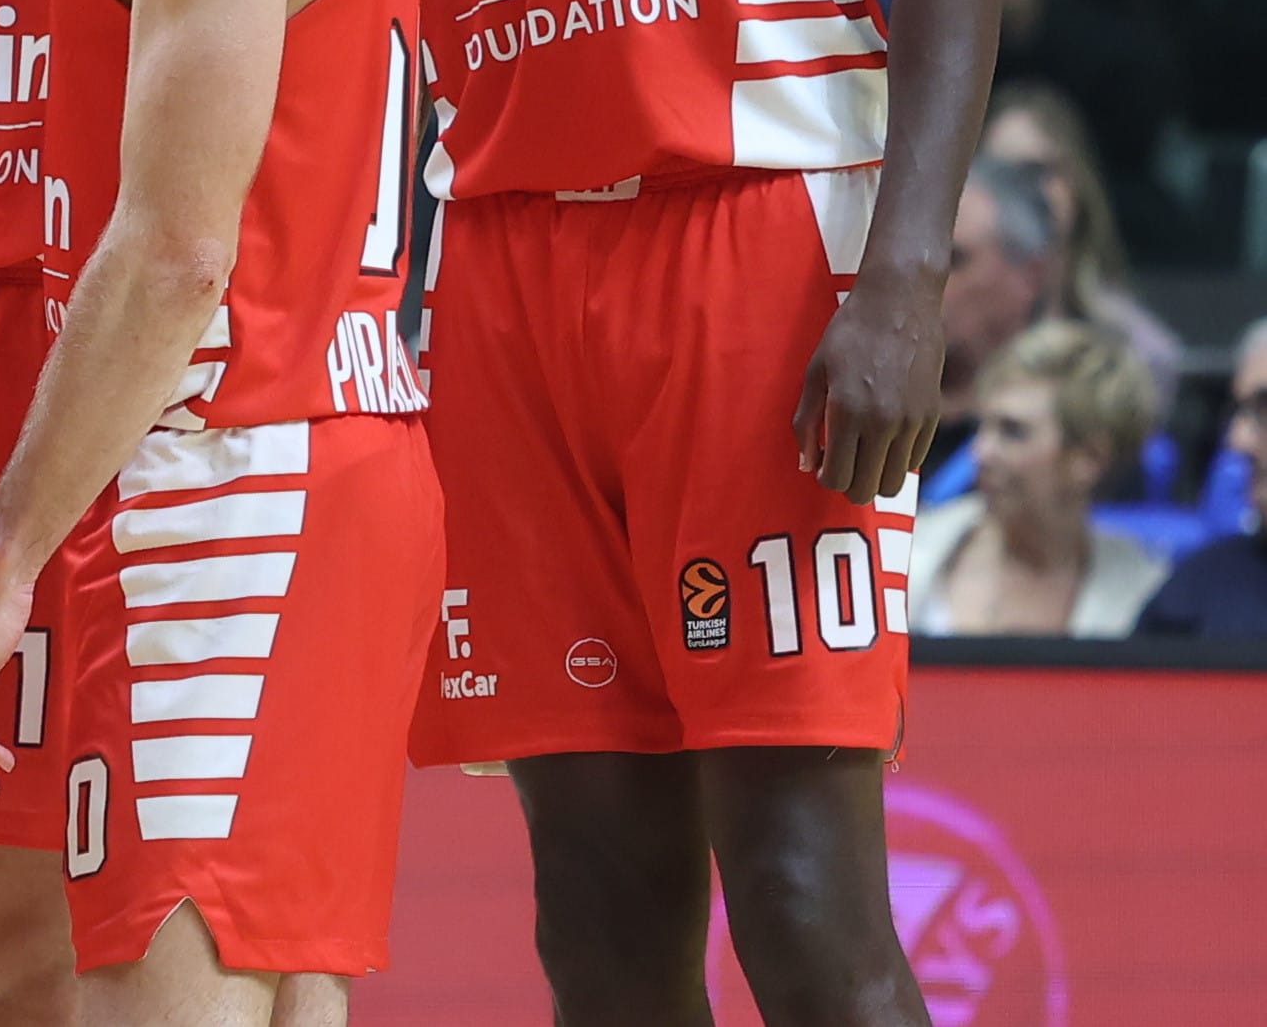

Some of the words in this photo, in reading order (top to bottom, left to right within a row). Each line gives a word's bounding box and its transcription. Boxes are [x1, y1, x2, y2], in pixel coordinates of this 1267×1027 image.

[747, 527, 878, 658] 10
[686, 618, 727, 630] TURKISH
[687, 627, 726, 639] AIRLINES
[570, 657, 614, 667] GSA
[64, 752, 109, 881] 0
